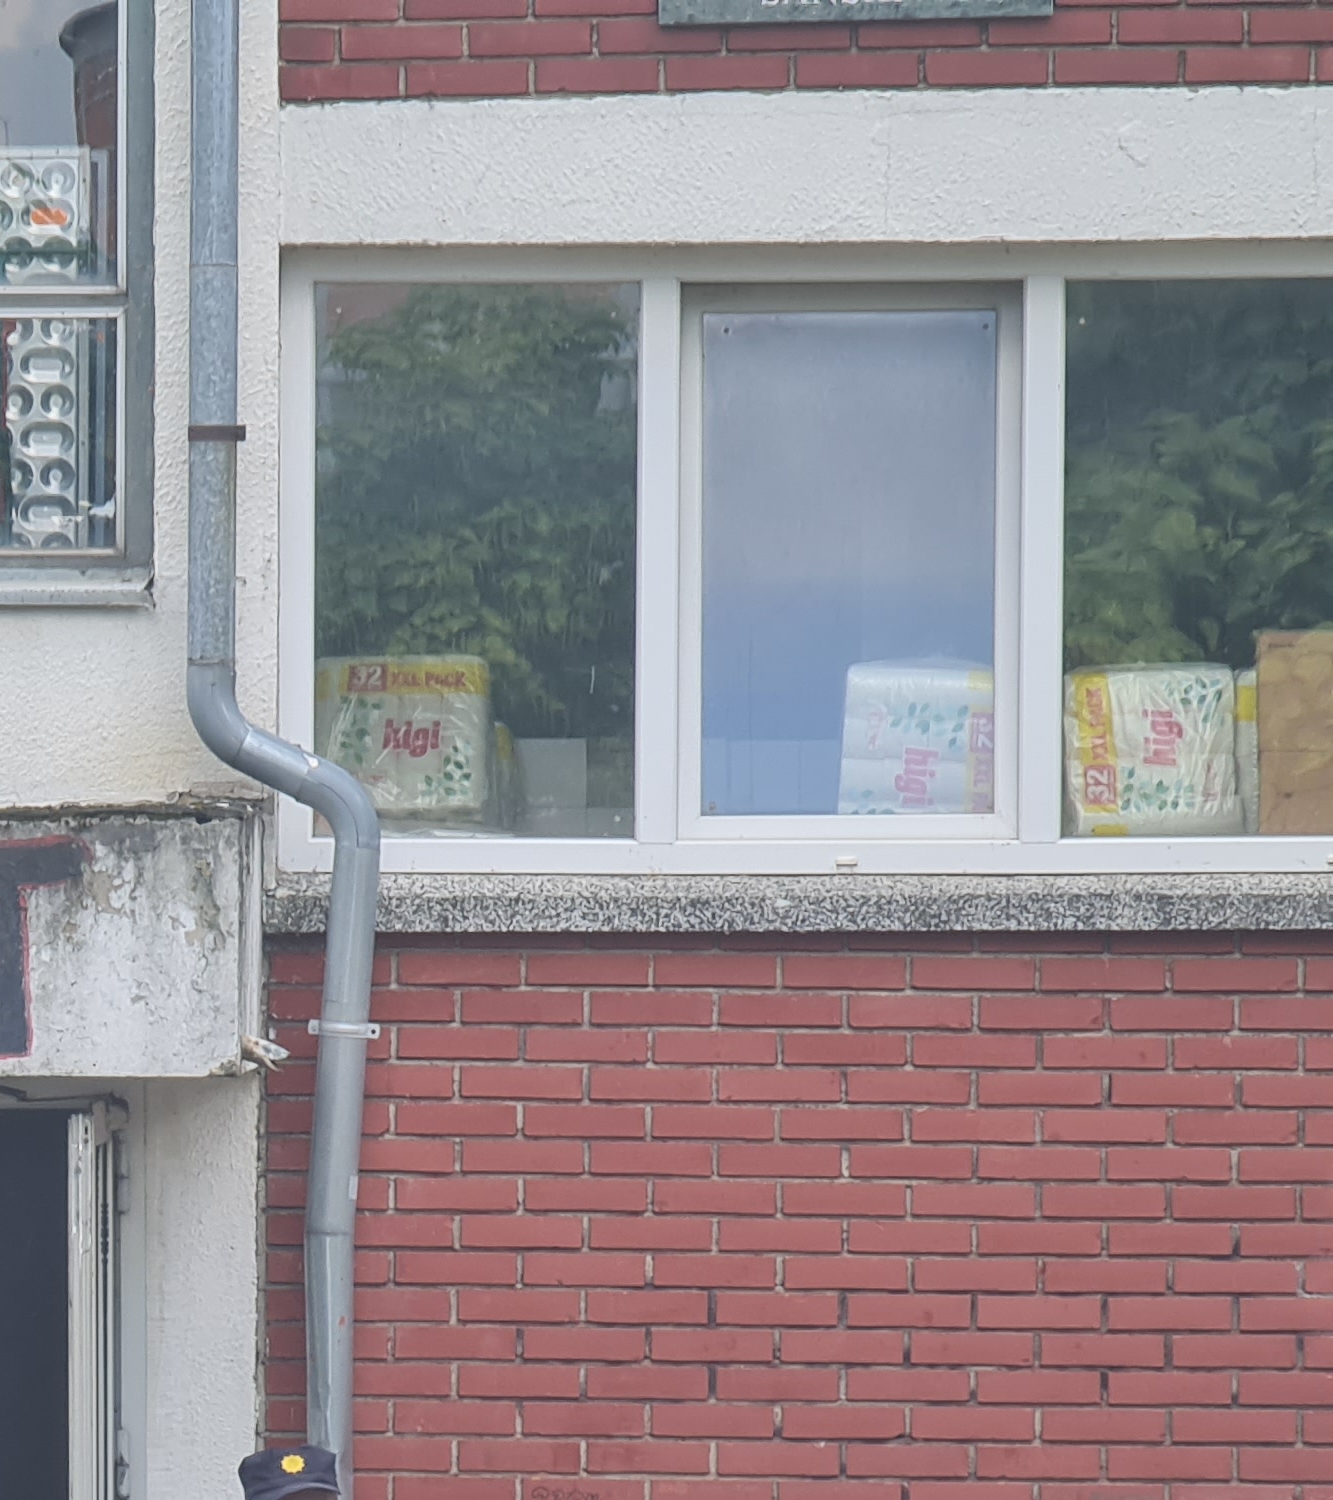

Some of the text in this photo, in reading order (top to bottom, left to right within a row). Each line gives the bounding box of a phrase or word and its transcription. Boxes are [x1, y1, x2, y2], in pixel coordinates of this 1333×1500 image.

[1142, 708, 1183, 766] higi
[894, 747, 940, 807] higi
[1086, 768, 1109, 802] 32
